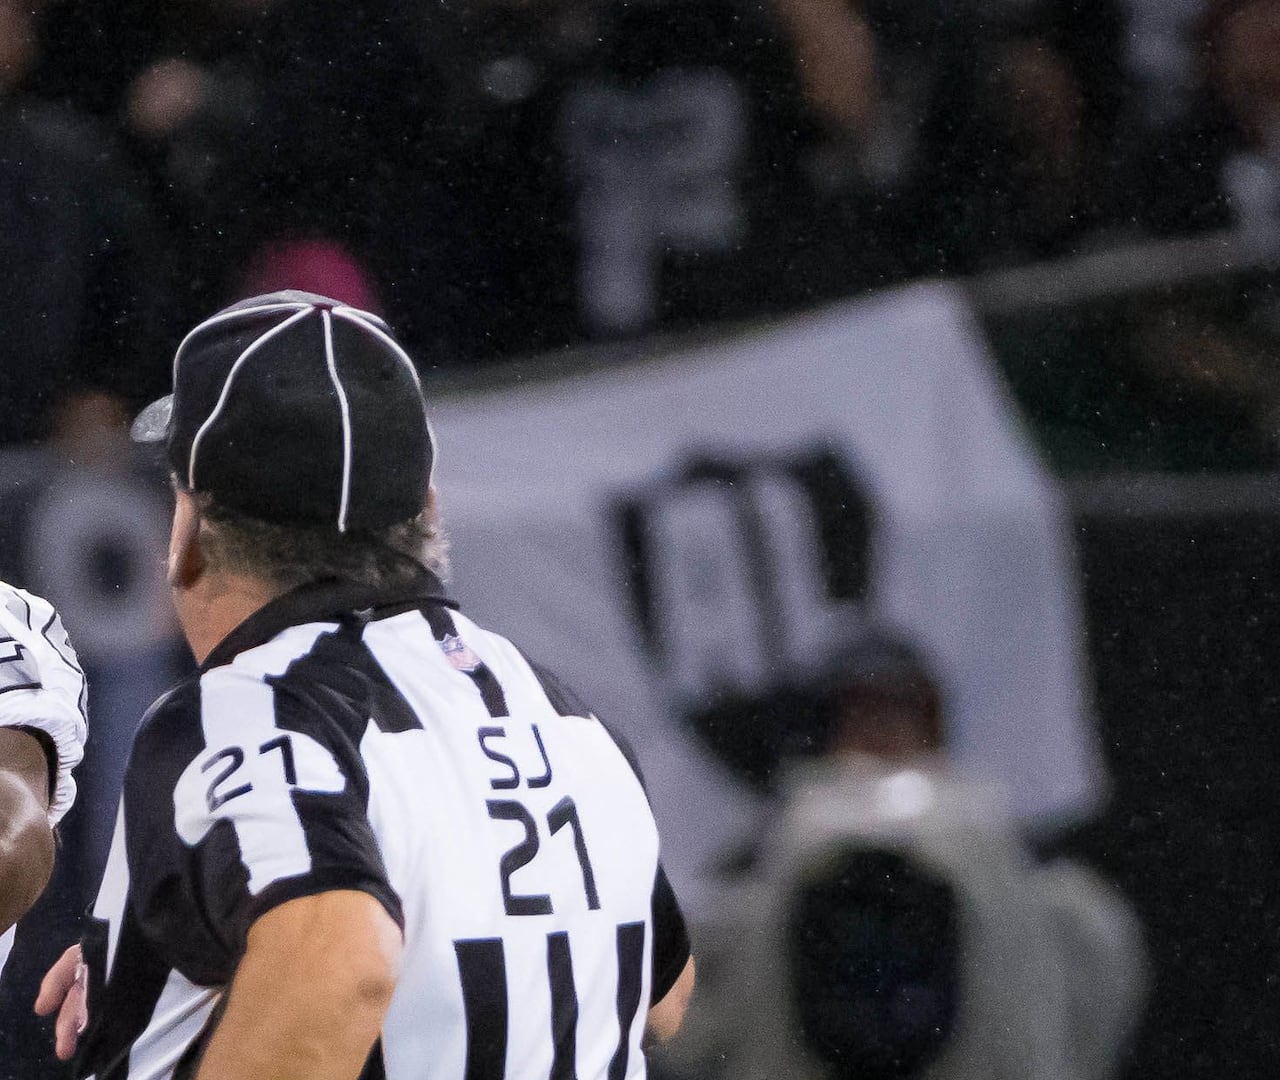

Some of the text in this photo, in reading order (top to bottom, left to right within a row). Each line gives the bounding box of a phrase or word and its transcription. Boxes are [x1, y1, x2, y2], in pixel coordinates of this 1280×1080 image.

[202, 734, 297, 811] 21
[478, 723, 554, 791] SJ
[486, 795, 602, 917] 21
